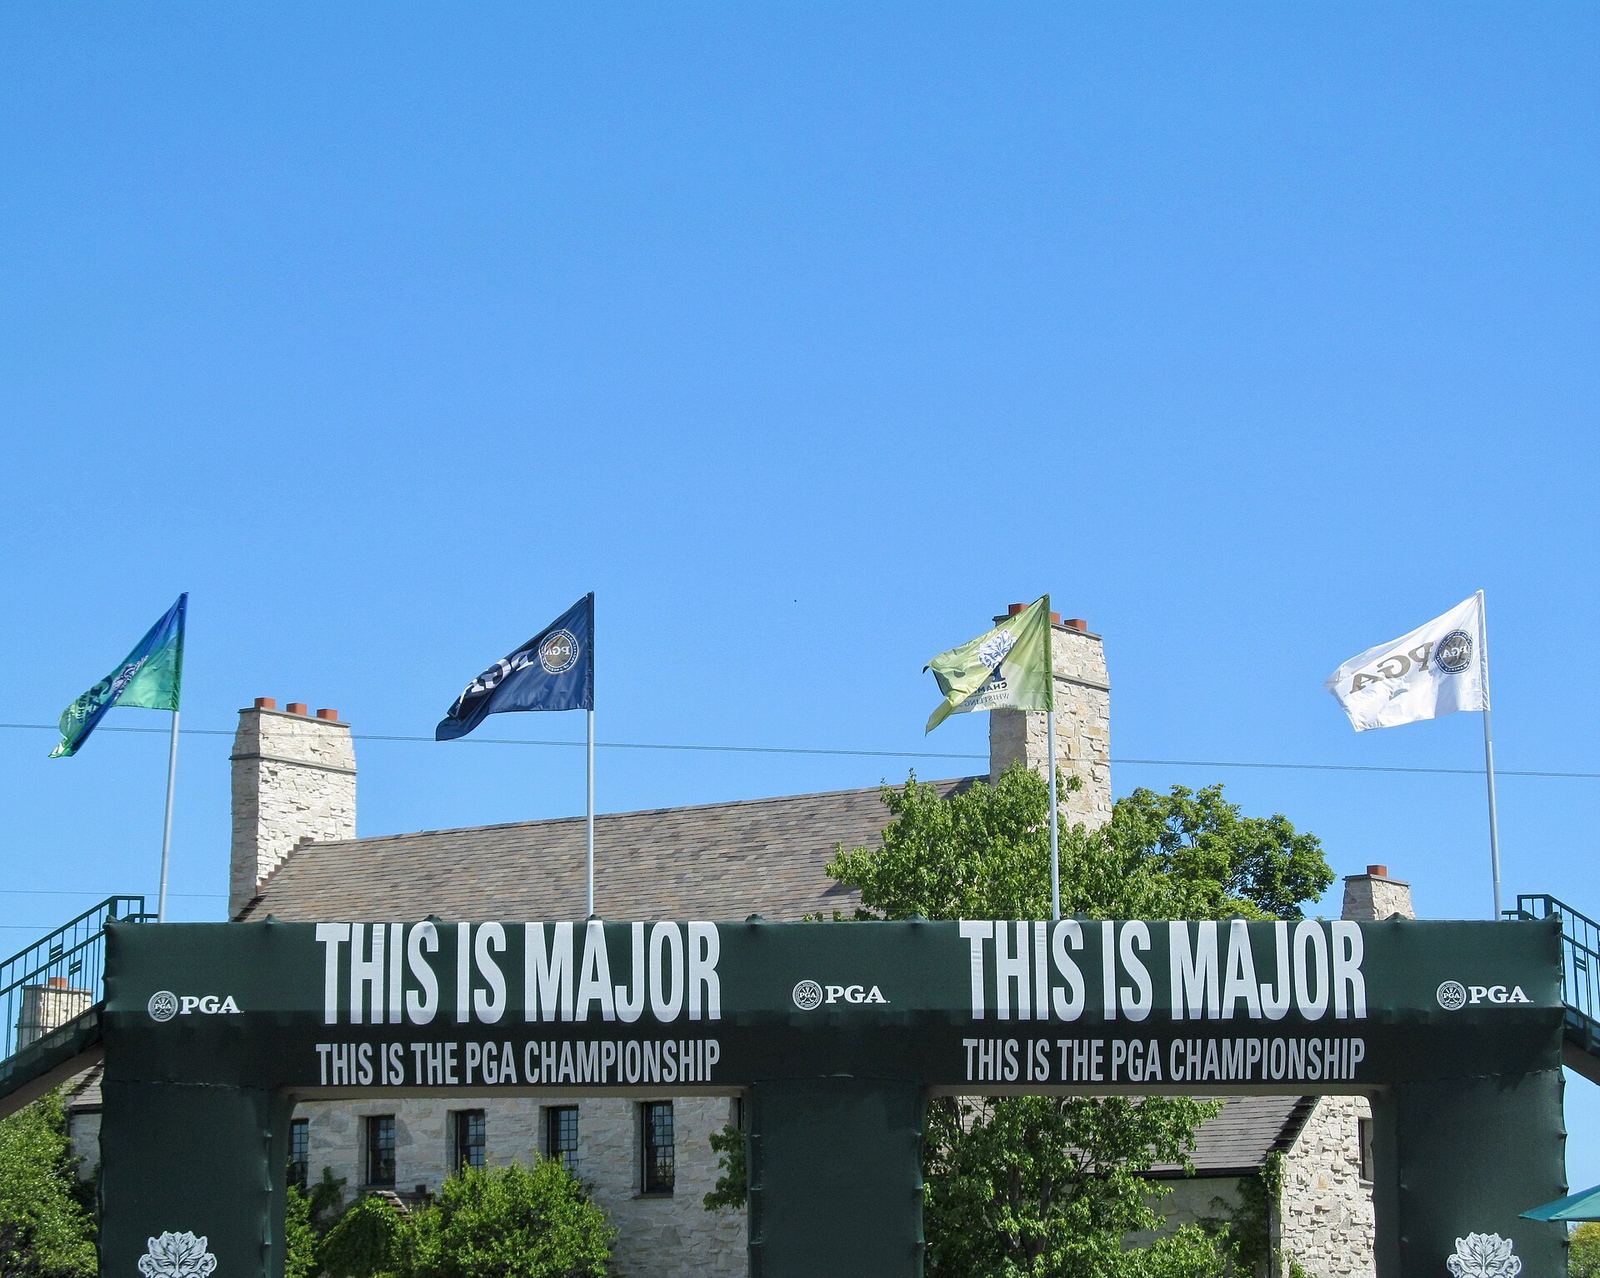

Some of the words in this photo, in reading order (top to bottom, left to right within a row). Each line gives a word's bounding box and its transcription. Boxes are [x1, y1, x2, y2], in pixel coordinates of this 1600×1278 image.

[316, 922, 438, 1024] THIS
[457, 922, 506, 1023] IS
[525, 921, 721, 1022] MAJOR
[959, 919, 1085, 1021] THIS
[1102, 919, 1153, 1021] IS
[1169, 919, 1367, 1020] MAJOR
[180, 996, 240, 1014] PGA
[825, 985, 886, 1003] PGA
[1468, 986, 1530, 1003] PGA
[316, 1043, 373, 1085] THIS
[381, 1043, 404, 1085] IS
[411, 1043, 458, 1085] THE
[466, 1042, 517, 1084] PGA
[525, 1040, 720, 1083] CHAMPIONSHIP
[963, 1039, 1018, 1081] THIS
[1027, 1039, 1050, 1081] IS
[1057, 1039, 1103, 1081] THE
[1112, 1039, 1162, 1081] PGA
[1170, 1038, 1365, 1081] CHAMPIONSHIP
